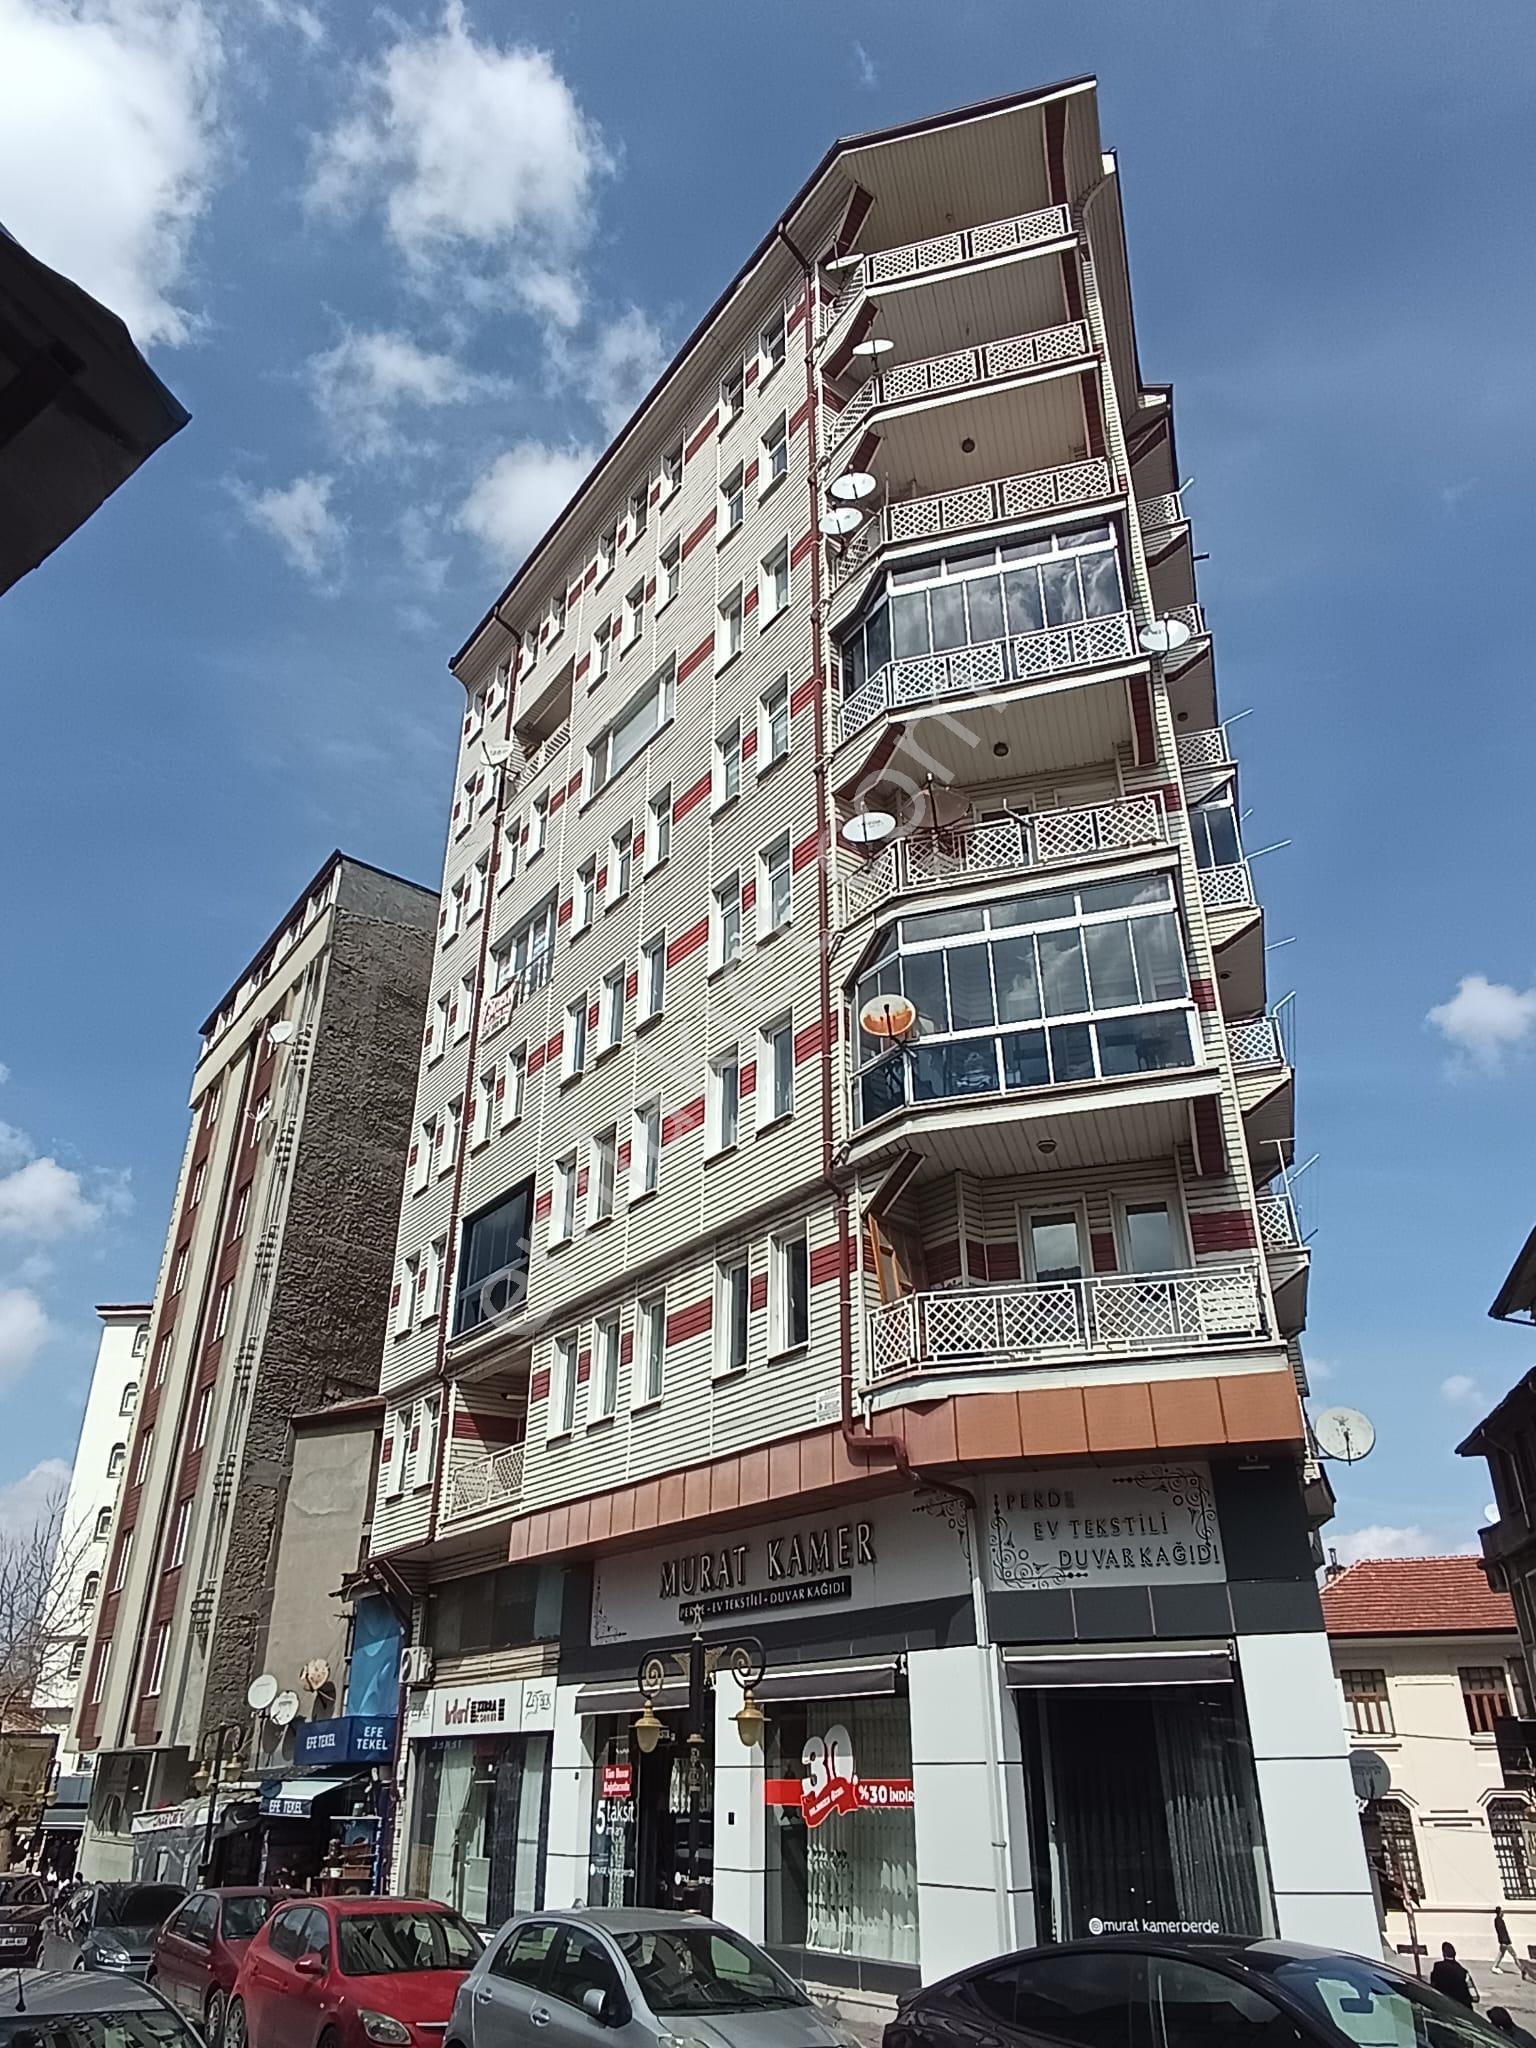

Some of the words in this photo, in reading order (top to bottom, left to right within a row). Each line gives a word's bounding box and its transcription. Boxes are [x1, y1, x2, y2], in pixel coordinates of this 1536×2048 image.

[1034, 1520, 1060, 1540] EV
[1068, 1511, 1169, 1538] TEKSTİLİ
[660, 1546, 748, 1598] MURAT
[767, 1521, 877, 1580] KAMER
[364, 1726, 384, 1738] EFE
[306, 1736, 317, 1750] EFE
[318, 1733, 336, 1748] TEKEL
[357, 1738, 389, 1750] TEKEL
[858, 1785, 888, 1804] %30
[269, 1799, 281, 1813] EFE
[283, 1800, 303, 1814] TEKEL
[595, 1799, 606, 1835] 5
[607, 1800, 635, 1823] taksit
[1103, 1918, 1140, 1933] murat
